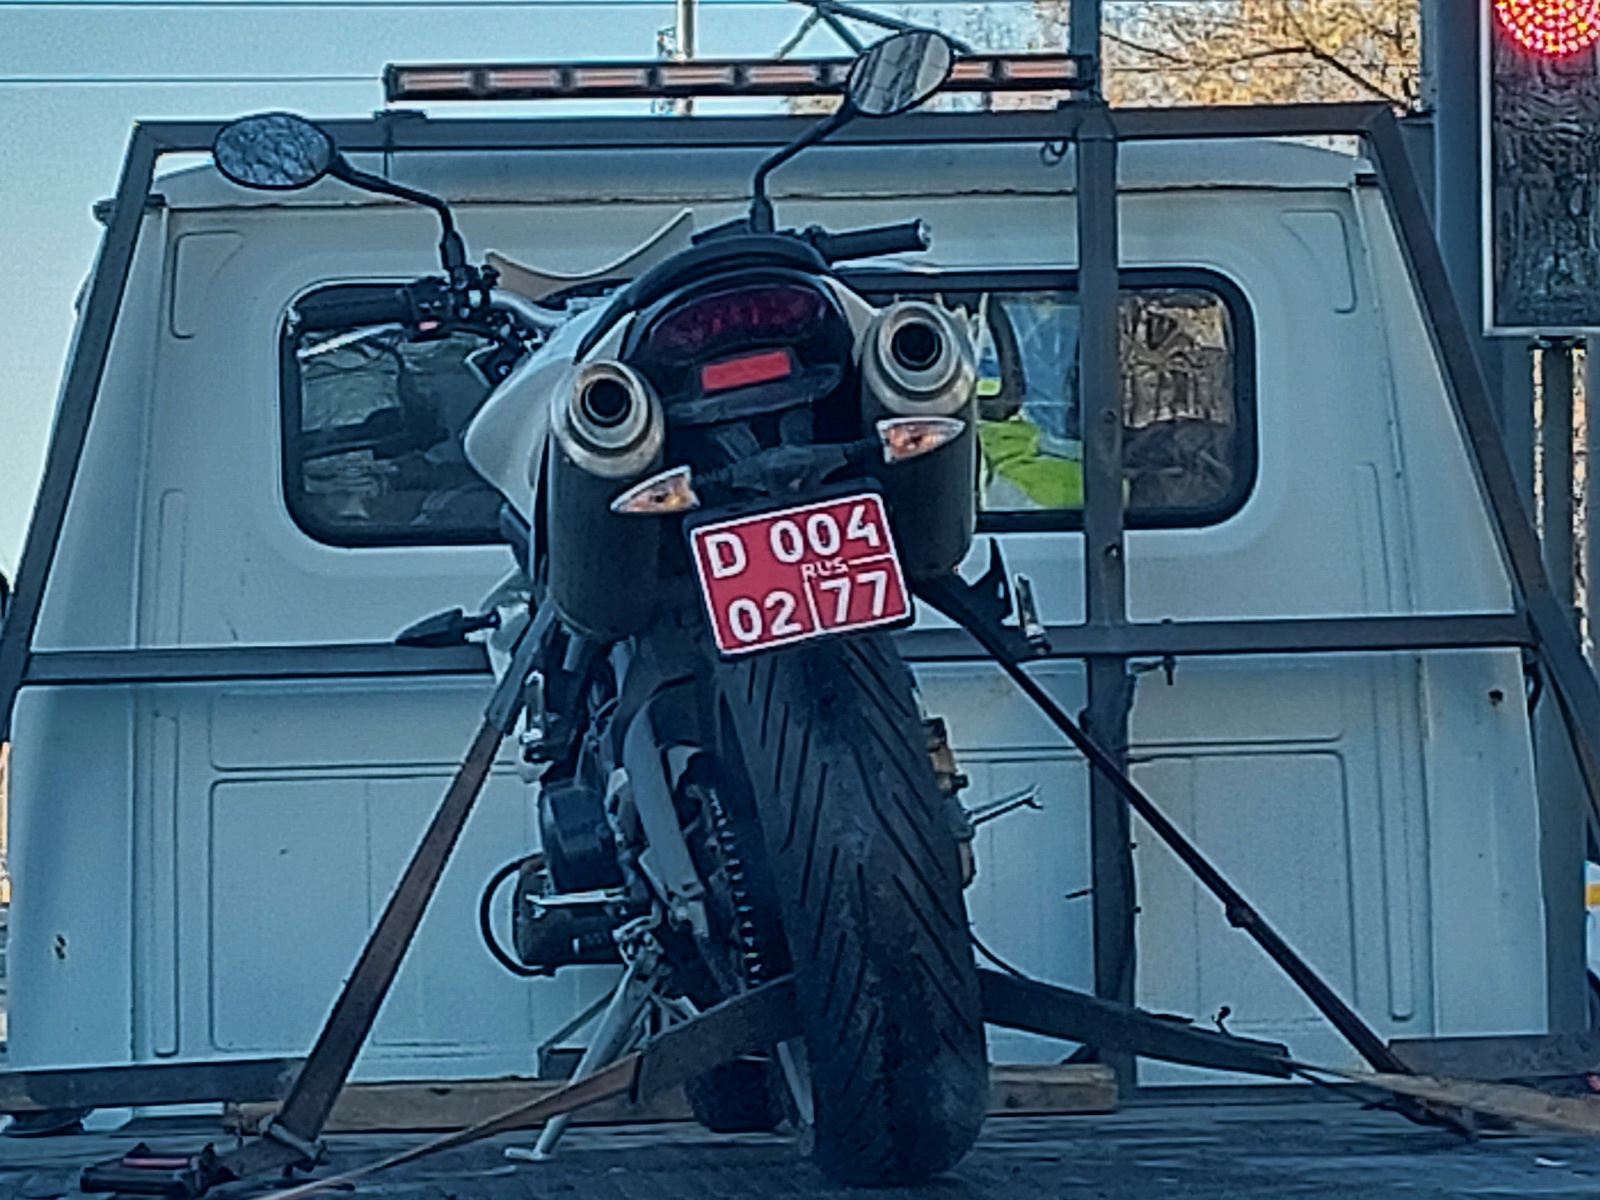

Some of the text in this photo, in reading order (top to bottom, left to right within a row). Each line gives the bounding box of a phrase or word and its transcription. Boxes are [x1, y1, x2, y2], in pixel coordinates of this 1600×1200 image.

[704, 504, 882, 580] D 004
[801, 556, 850, 581] RUS
[728, 570, 888, 643] 02 77
